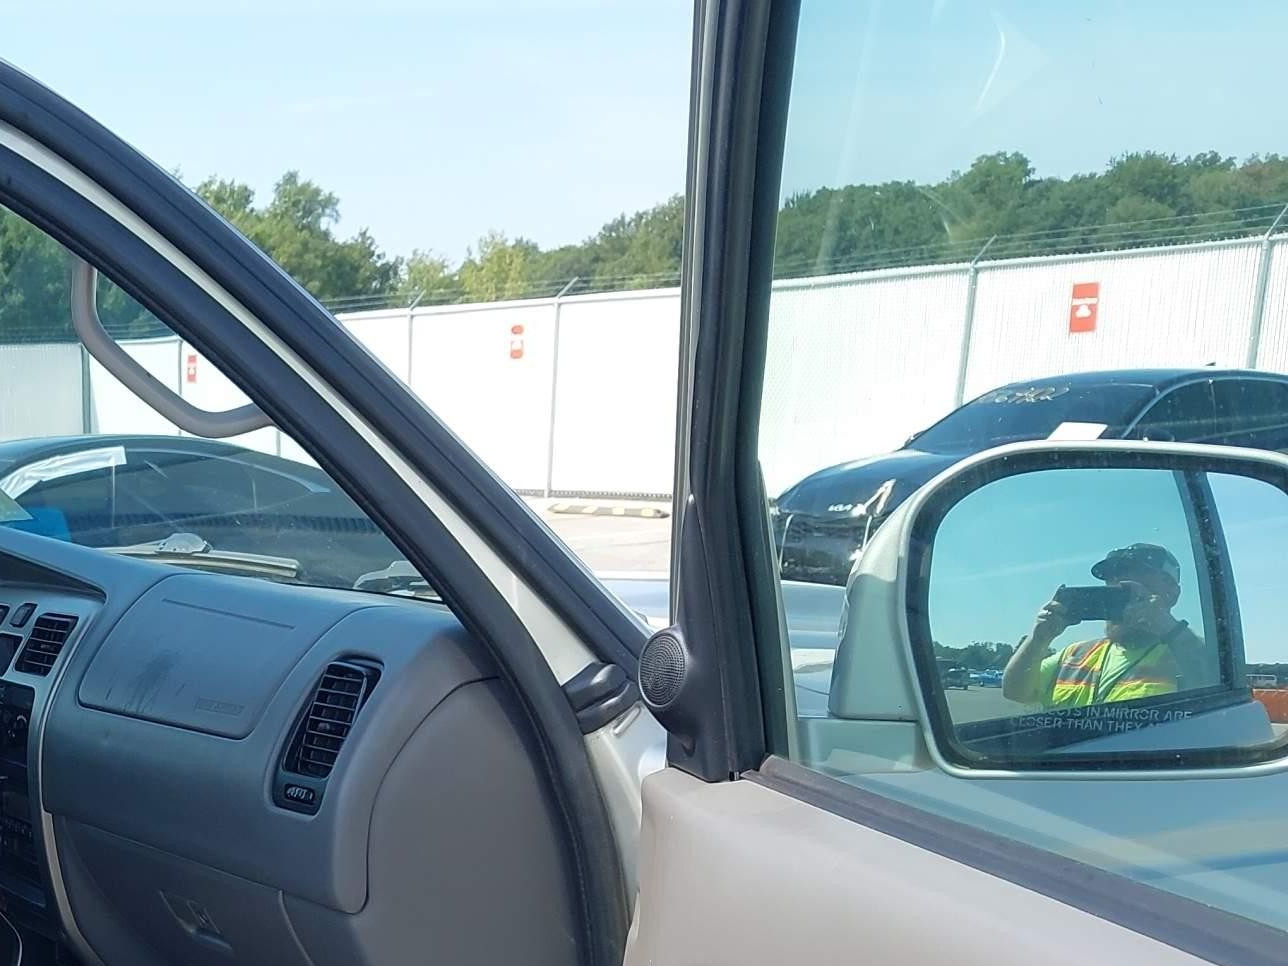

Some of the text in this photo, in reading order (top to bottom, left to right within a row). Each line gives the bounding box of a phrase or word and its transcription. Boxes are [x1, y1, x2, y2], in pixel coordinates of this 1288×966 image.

[1085, 706, 1100, 718] IN
[1103, 706, 1160, 721] MIRROR
[1066, 718, 1103, 731] THAN
